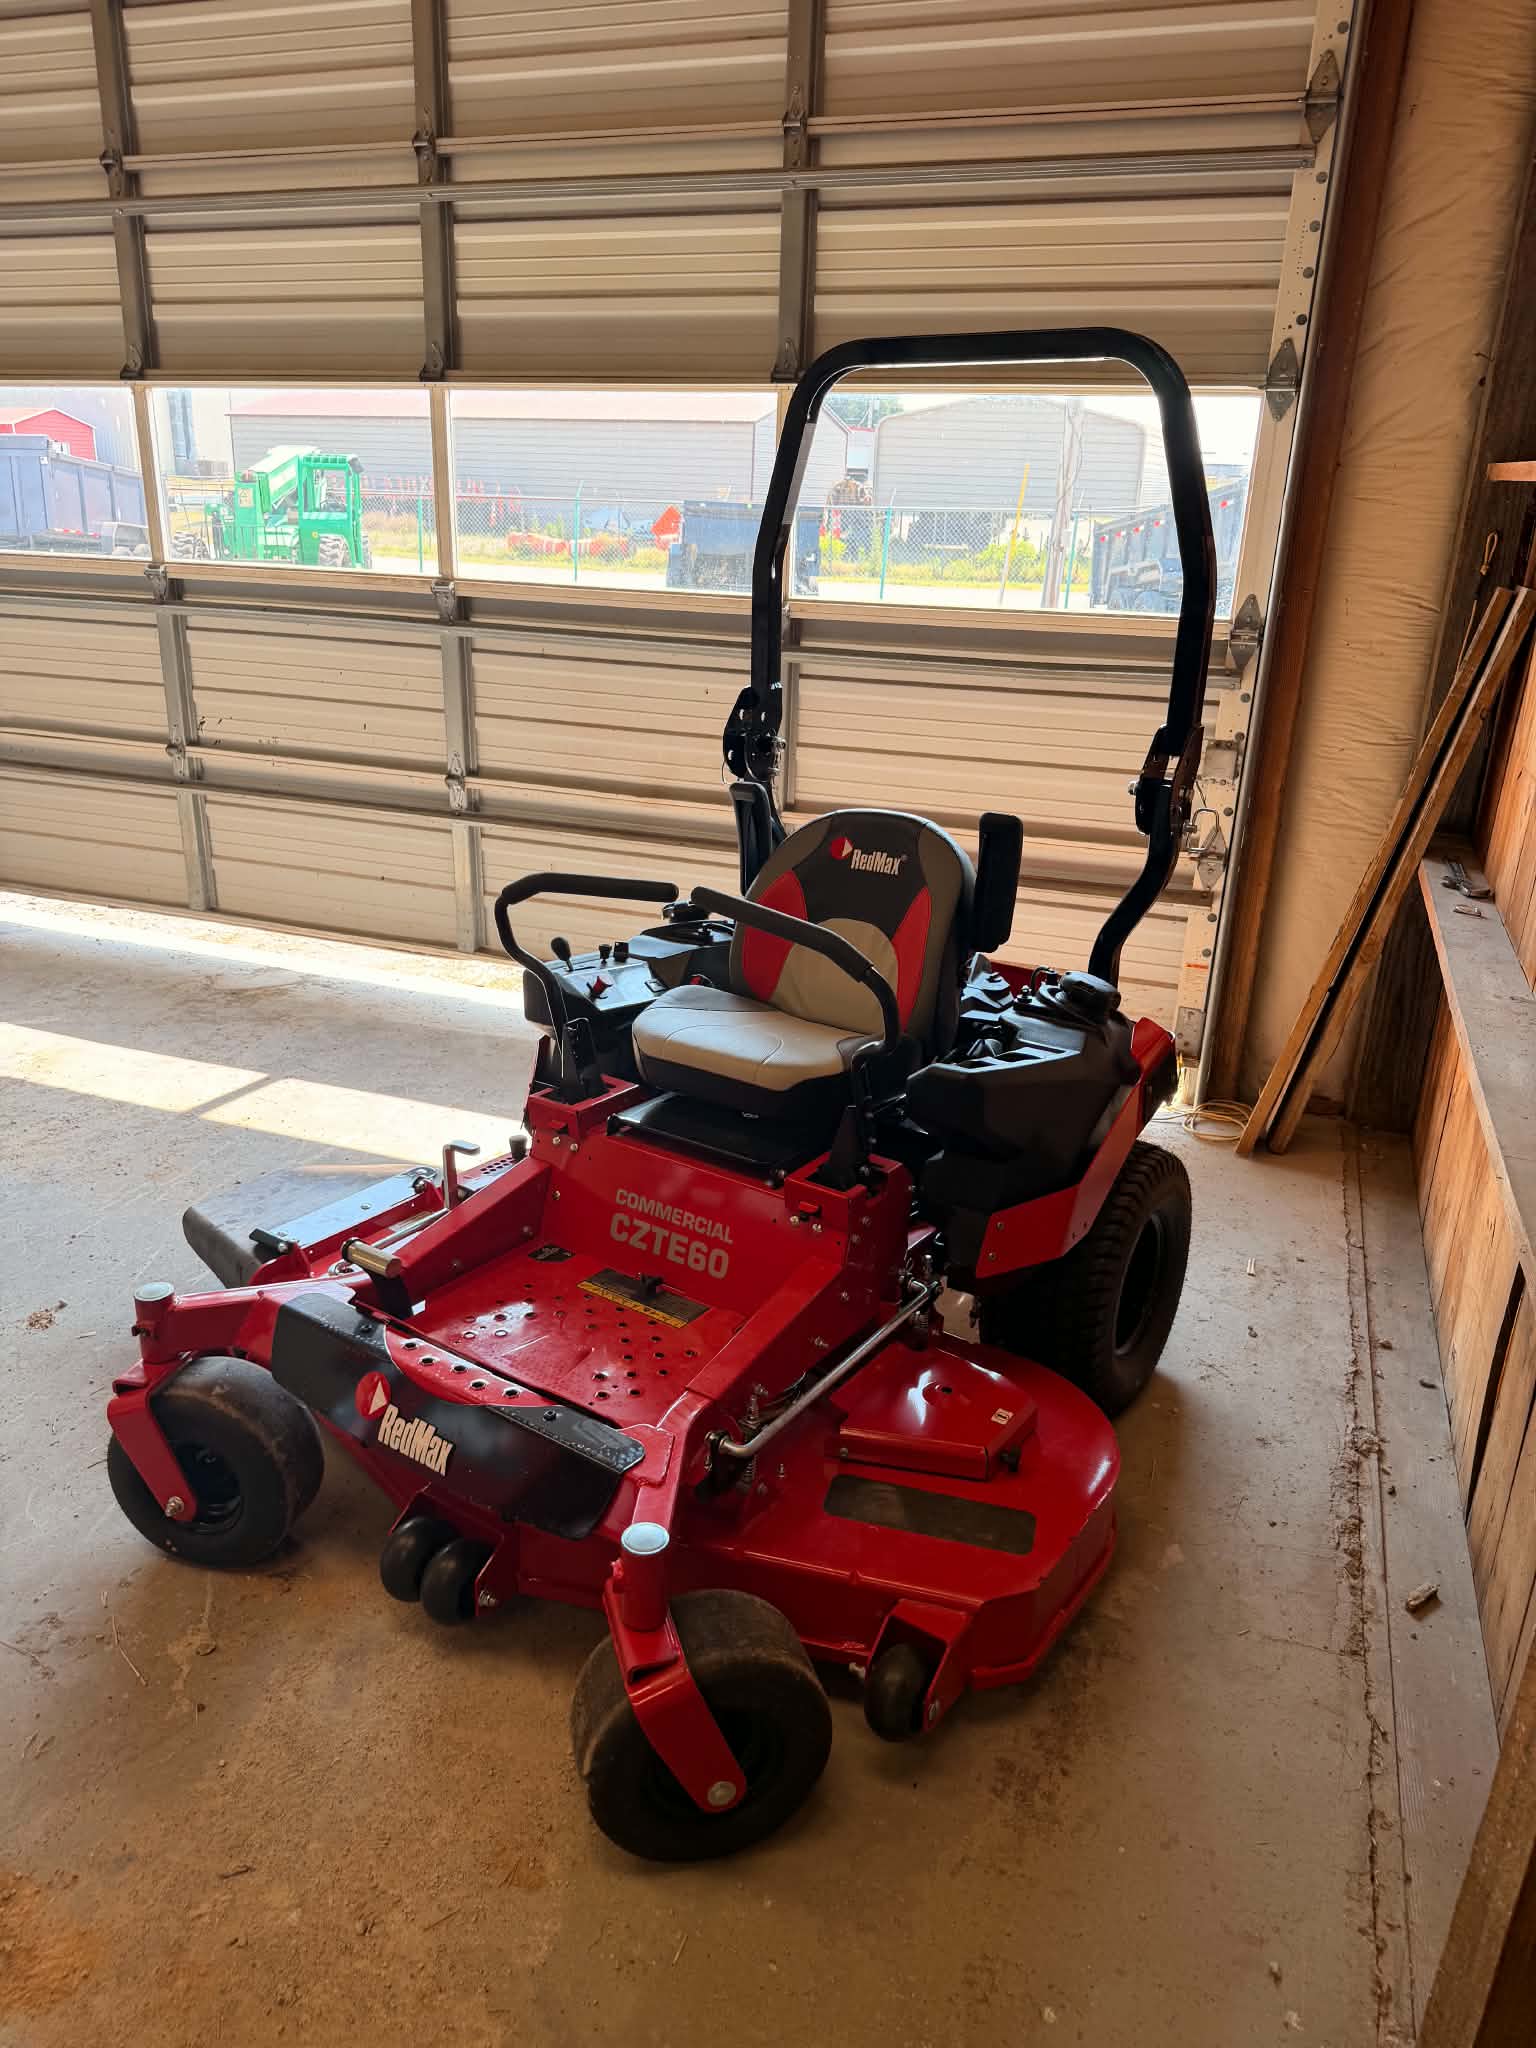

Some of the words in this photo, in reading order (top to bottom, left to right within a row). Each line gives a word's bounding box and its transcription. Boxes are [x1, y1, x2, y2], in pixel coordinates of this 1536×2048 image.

[610, 1213, 729, 1279] CZTE60
[615, 1189, 734, 1244] COMMERCIAL
[377, 1403, 453, 1476] RedMax
